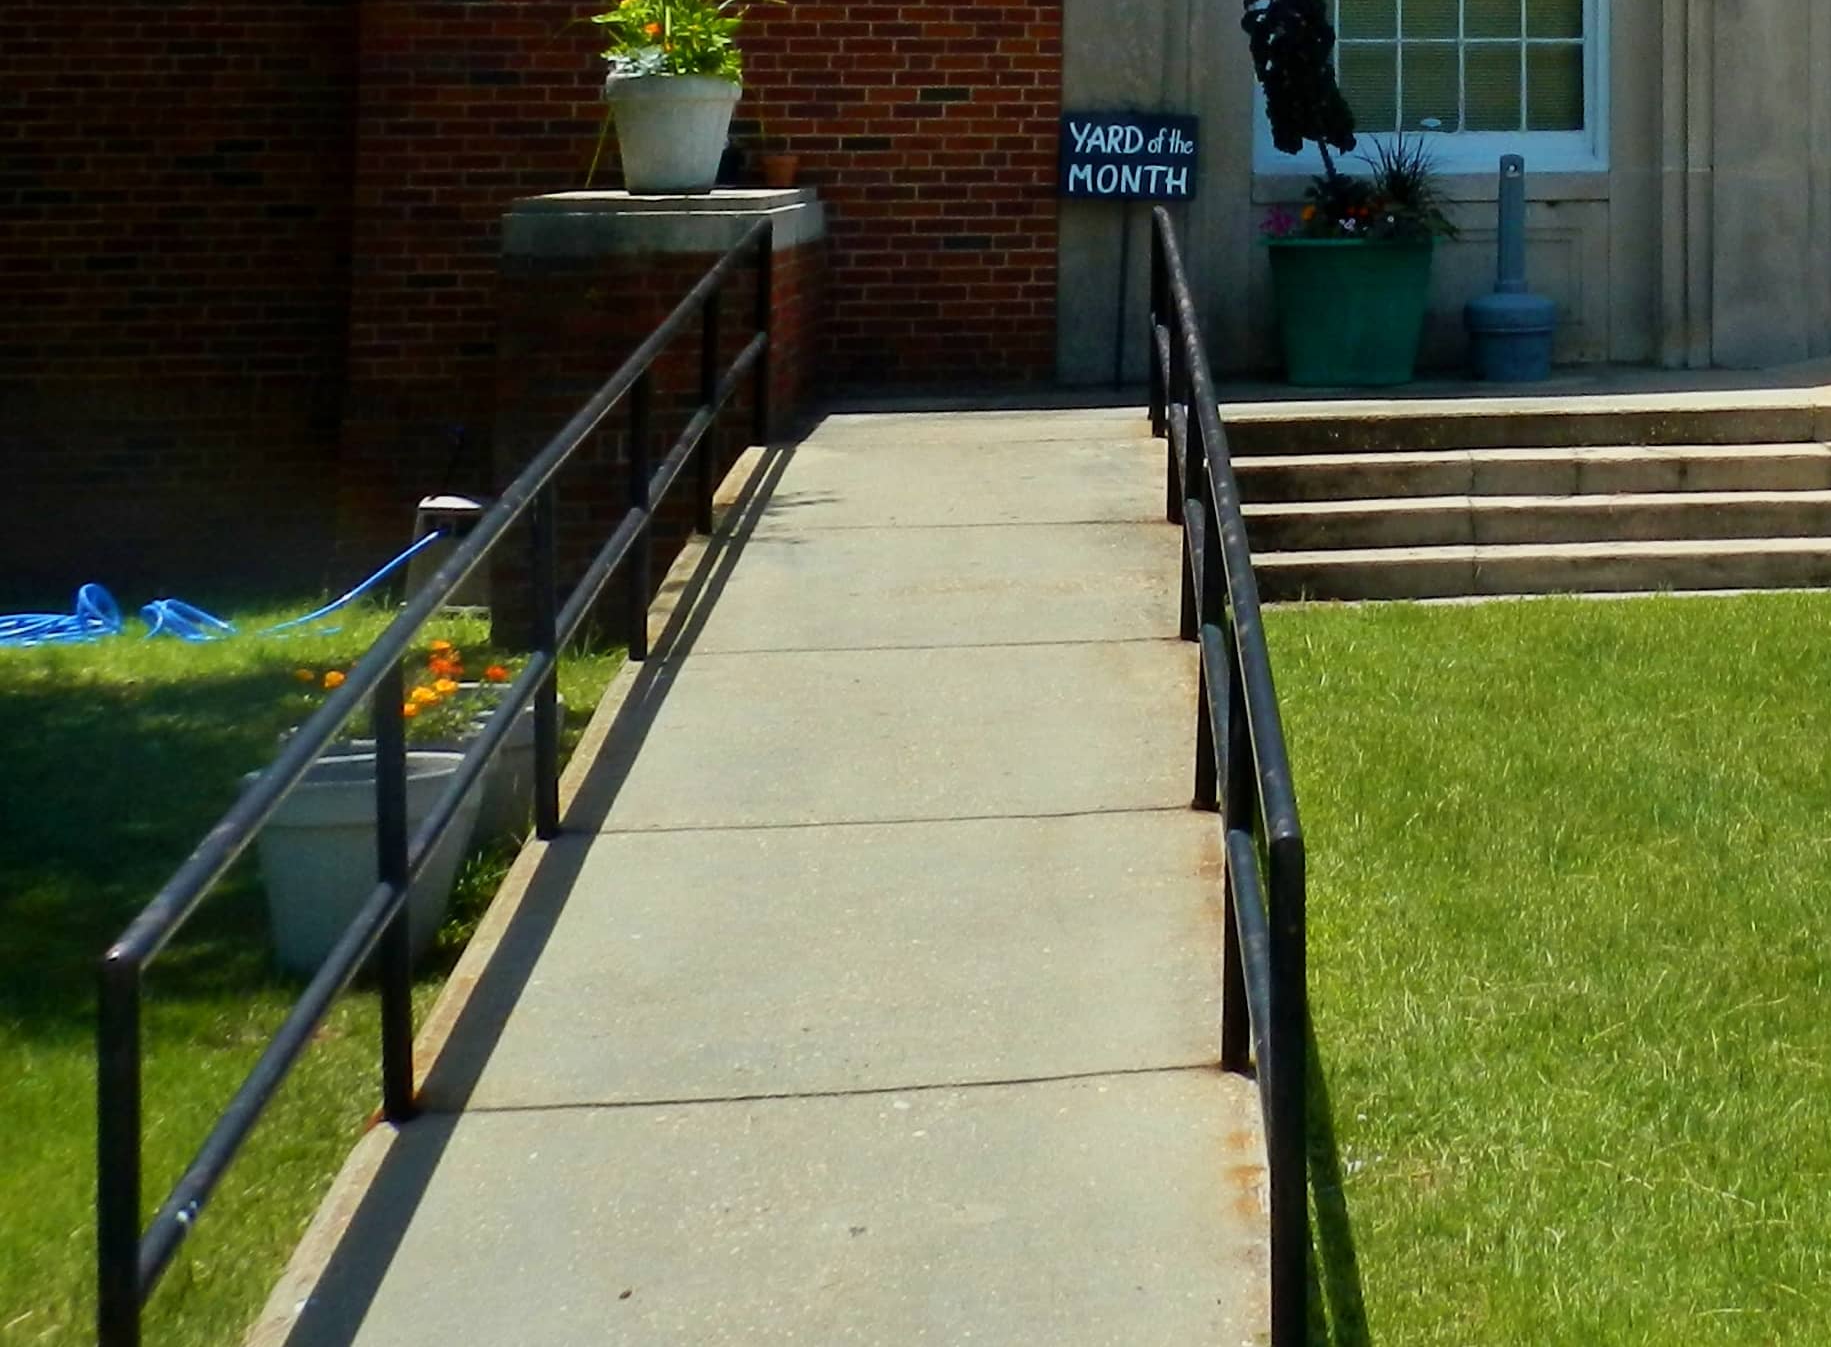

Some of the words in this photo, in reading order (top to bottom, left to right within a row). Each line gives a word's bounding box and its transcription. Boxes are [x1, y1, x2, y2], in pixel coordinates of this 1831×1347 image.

[1069, 122, 1144, 154] YARD
[1147, 127, 1167, 154] of
[1169, 128, 1194, 155] the
[1068, 163, 1188, 195] MONTH
